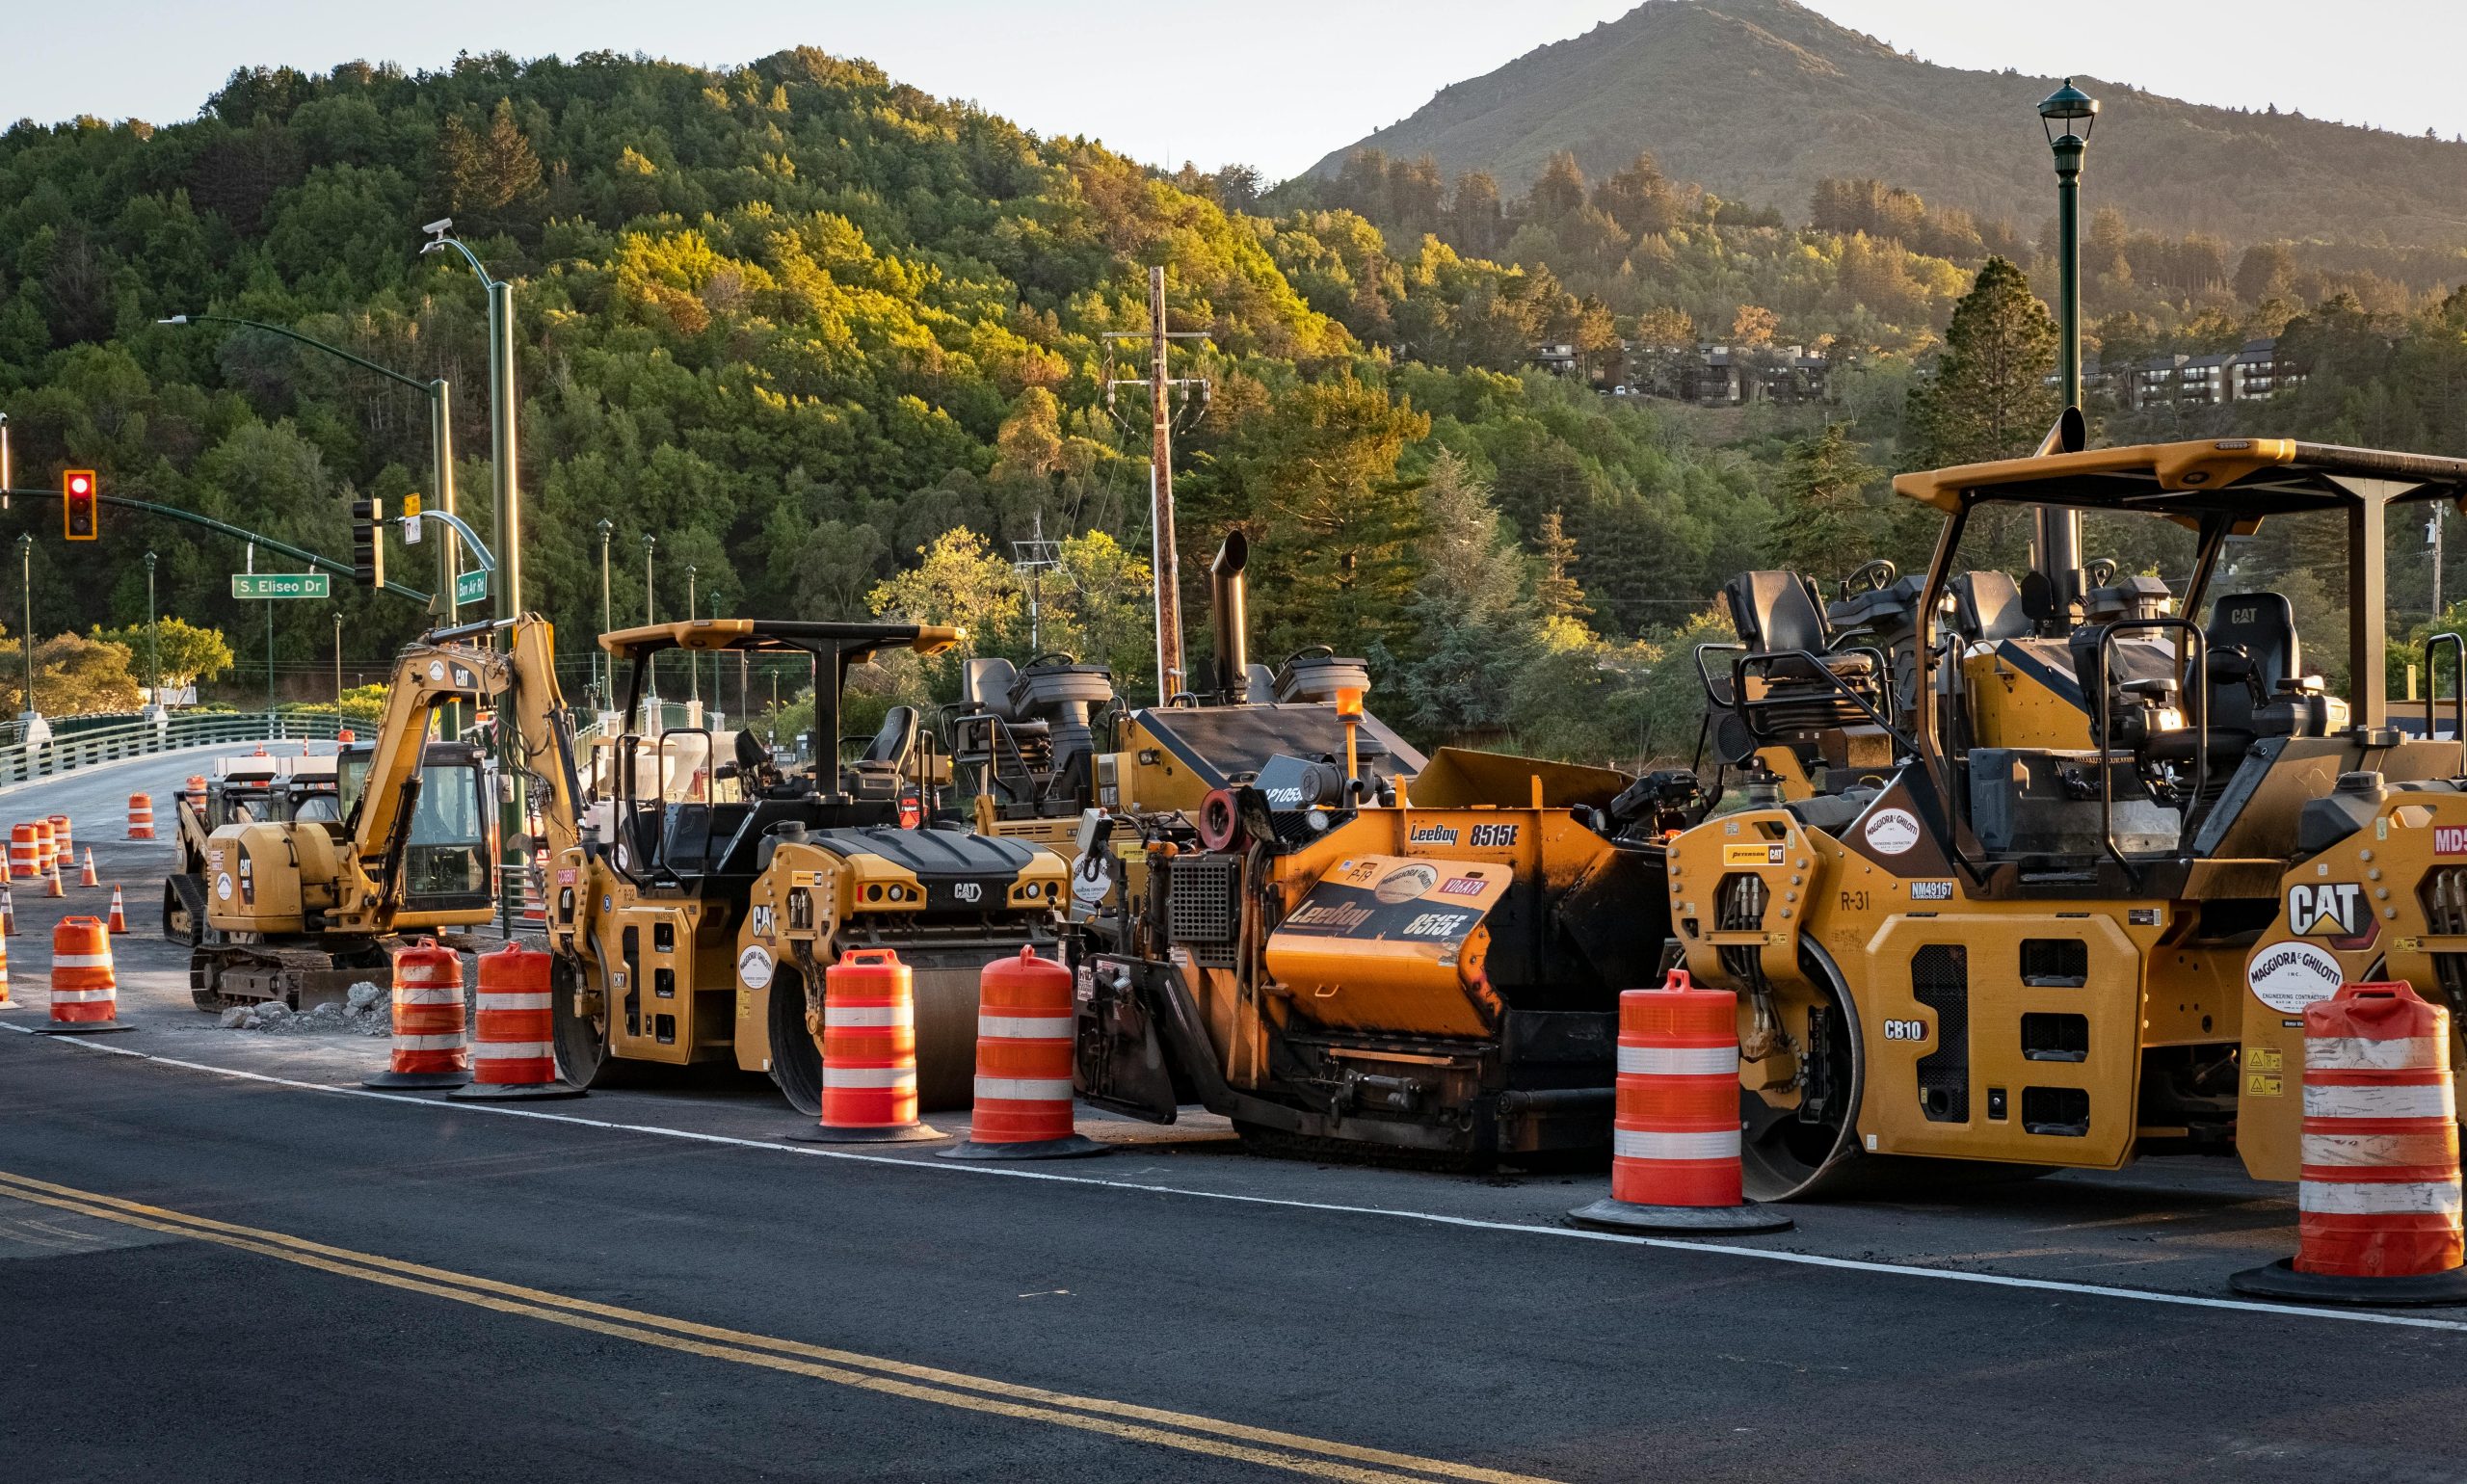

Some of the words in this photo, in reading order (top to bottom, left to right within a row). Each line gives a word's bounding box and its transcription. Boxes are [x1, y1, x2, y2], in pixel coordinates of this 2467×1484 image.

[240, 580, 252, 592] S.
[258, 580, 299, 592] Eliseo
[305, 580, 321, 592] Dr
[459, 582, 467, 596] Bon
[477, 578, 484, 592] Rd
[2231, 608, 2257, 623] CAT
[456, 670, 468, 686] CAT
[1867, 815, 1894, 836] MAGGIORA
[1897, 815, 1918, 835] GHILOTTI
[1410, 824, 1458, 846] LeeBoy
[1470, 824, 1519, 846] 8515E
[1769, 850, 1783, 860] CAT
[240, 860, 251, 876] CAT
[1346, 869, 1372, 882] P-19
[955, 884, 975, 899] CAT
[1444, 878, 1484, 895] VD6A78
[1912, 883, 1952, 895] NM49167
[1841, 891, 1870, 911] R-31
[1285, 899, 1376, 935] LeeBoy
[2290, 884, 2359, 935] CAT
[2251, 952, 2296, 984] MAGGIORA
[2302, 953, 2340, 986] GHILOTTI
[614, 972, 624, 987] CB7
[1885, 1020, 1922, 1040] CB10
